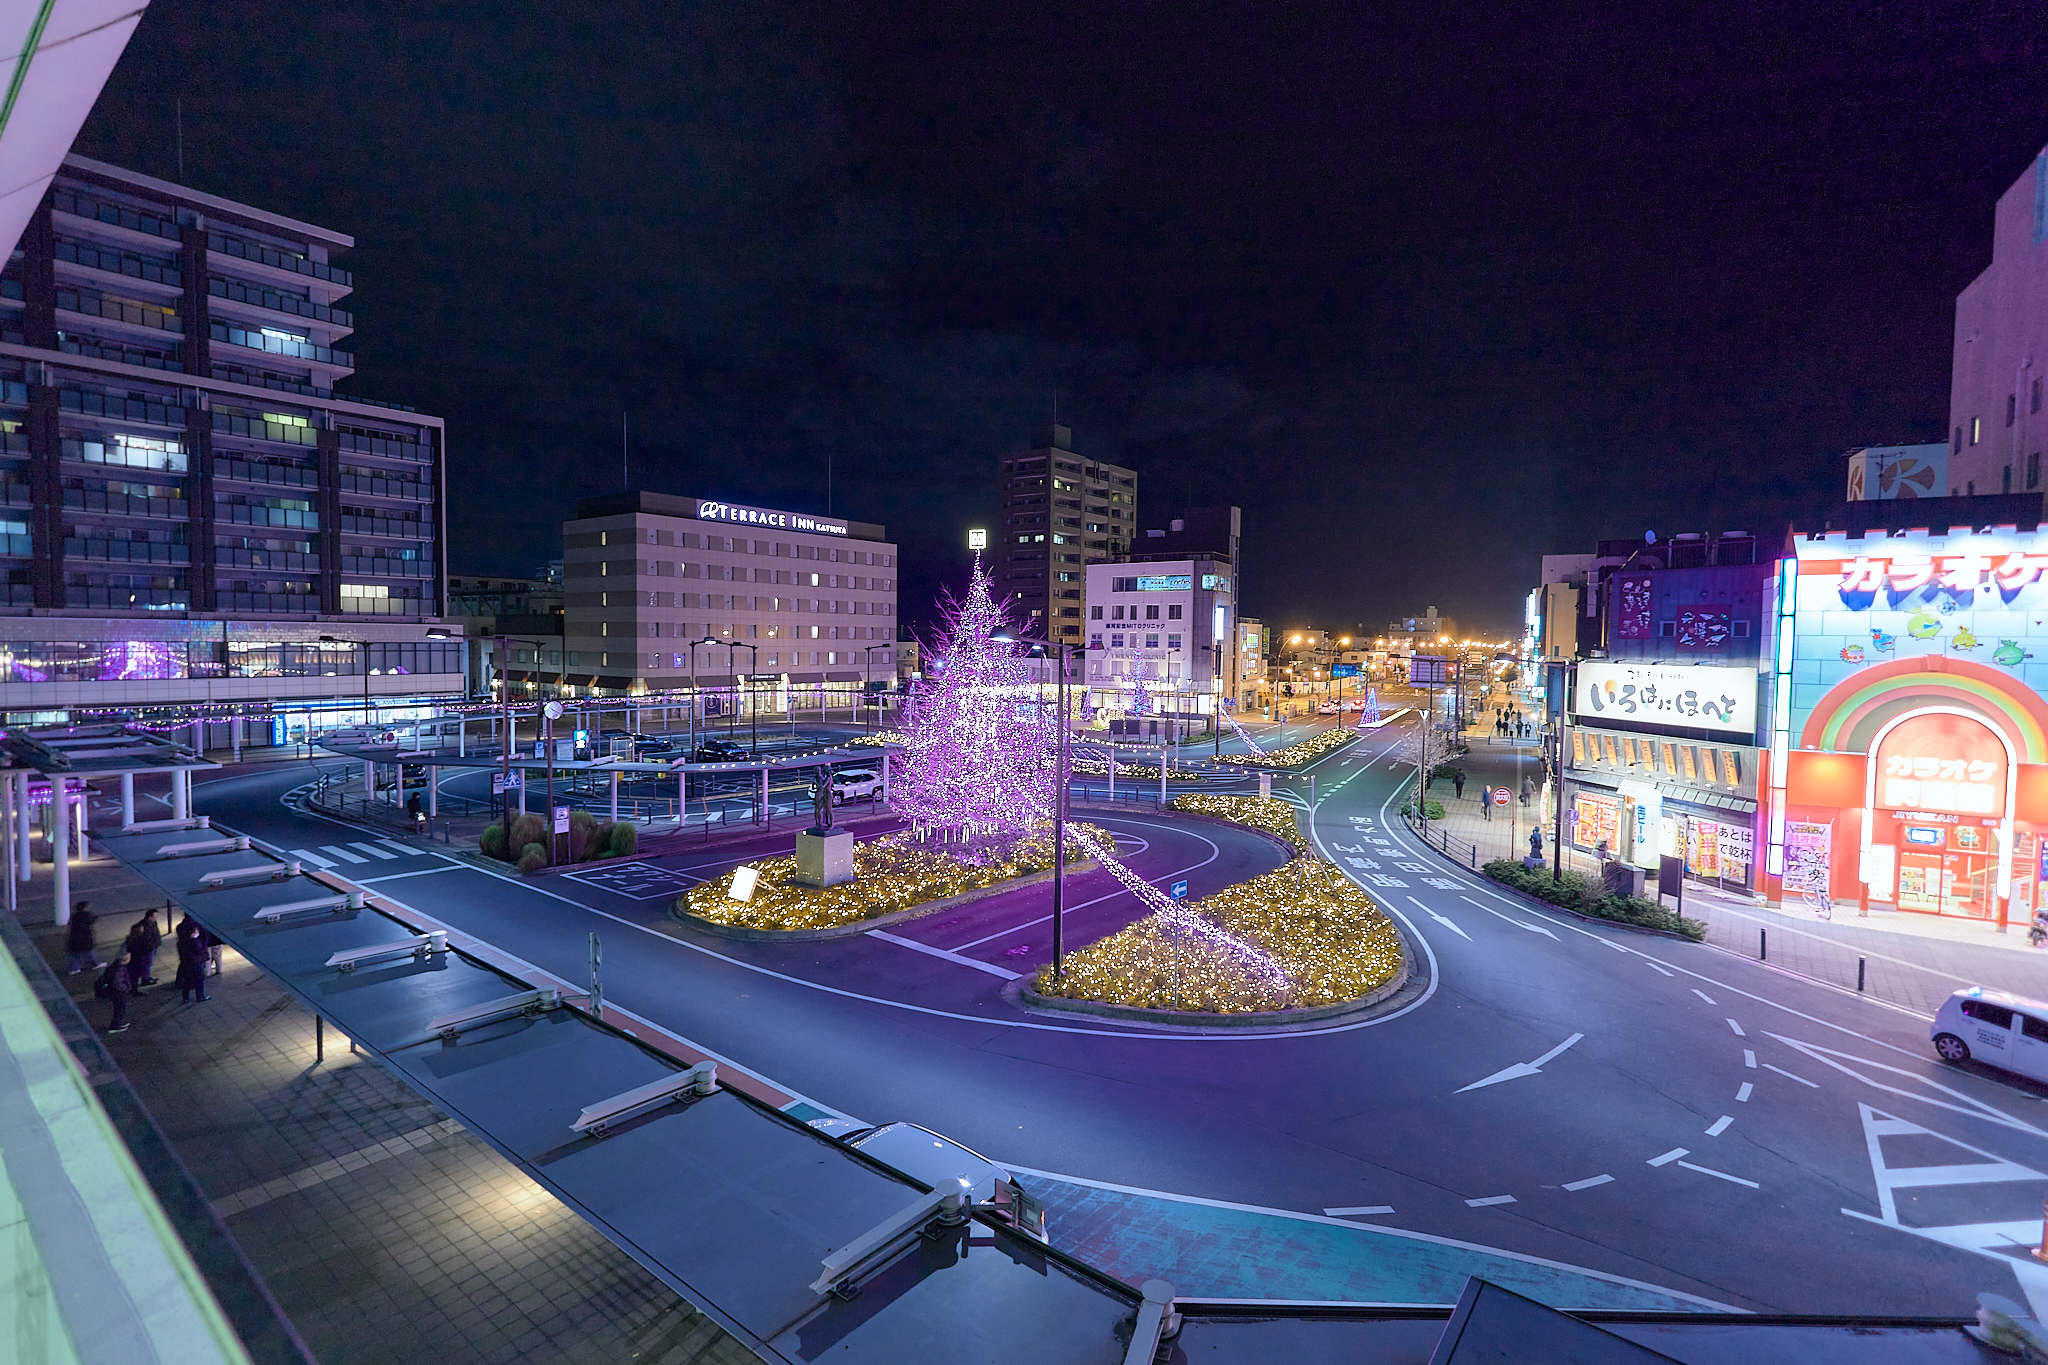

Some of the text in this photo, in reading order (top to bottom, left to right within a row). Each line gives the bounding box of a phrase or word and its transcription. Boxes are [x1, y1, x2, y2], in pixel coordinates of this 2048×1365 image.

[718, 504, 848, 535] TERRACE INN KATSUTA
[1838, 551, 2048, 592] カラオケ
[1590, 683, 1736, 720] いろはにほへと
[576, 731, 586, 741] P
[1885, 755, 1997, 781] カラオケ
